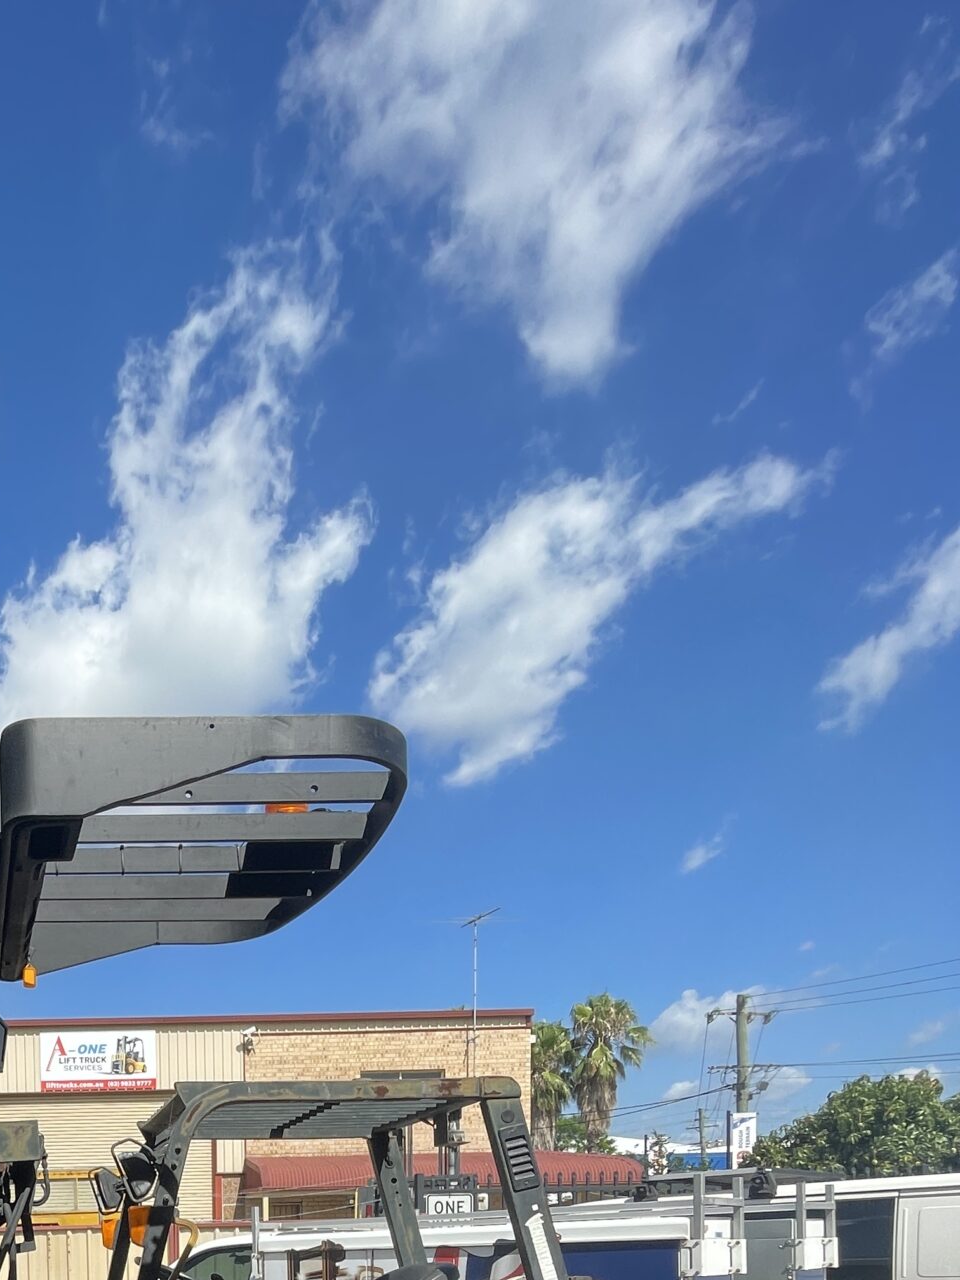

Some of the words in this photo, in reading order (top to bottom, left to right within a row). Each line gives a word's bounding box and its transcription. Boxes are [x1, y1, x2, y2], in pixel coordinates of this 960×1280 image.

[58, 1057, 78, 1065] LIFT
[79, 1056, 107, 1064] TRUCK
[63, 1064, 103, 1072] SERVICES
[434, 1200, 465, 1215] ONE
